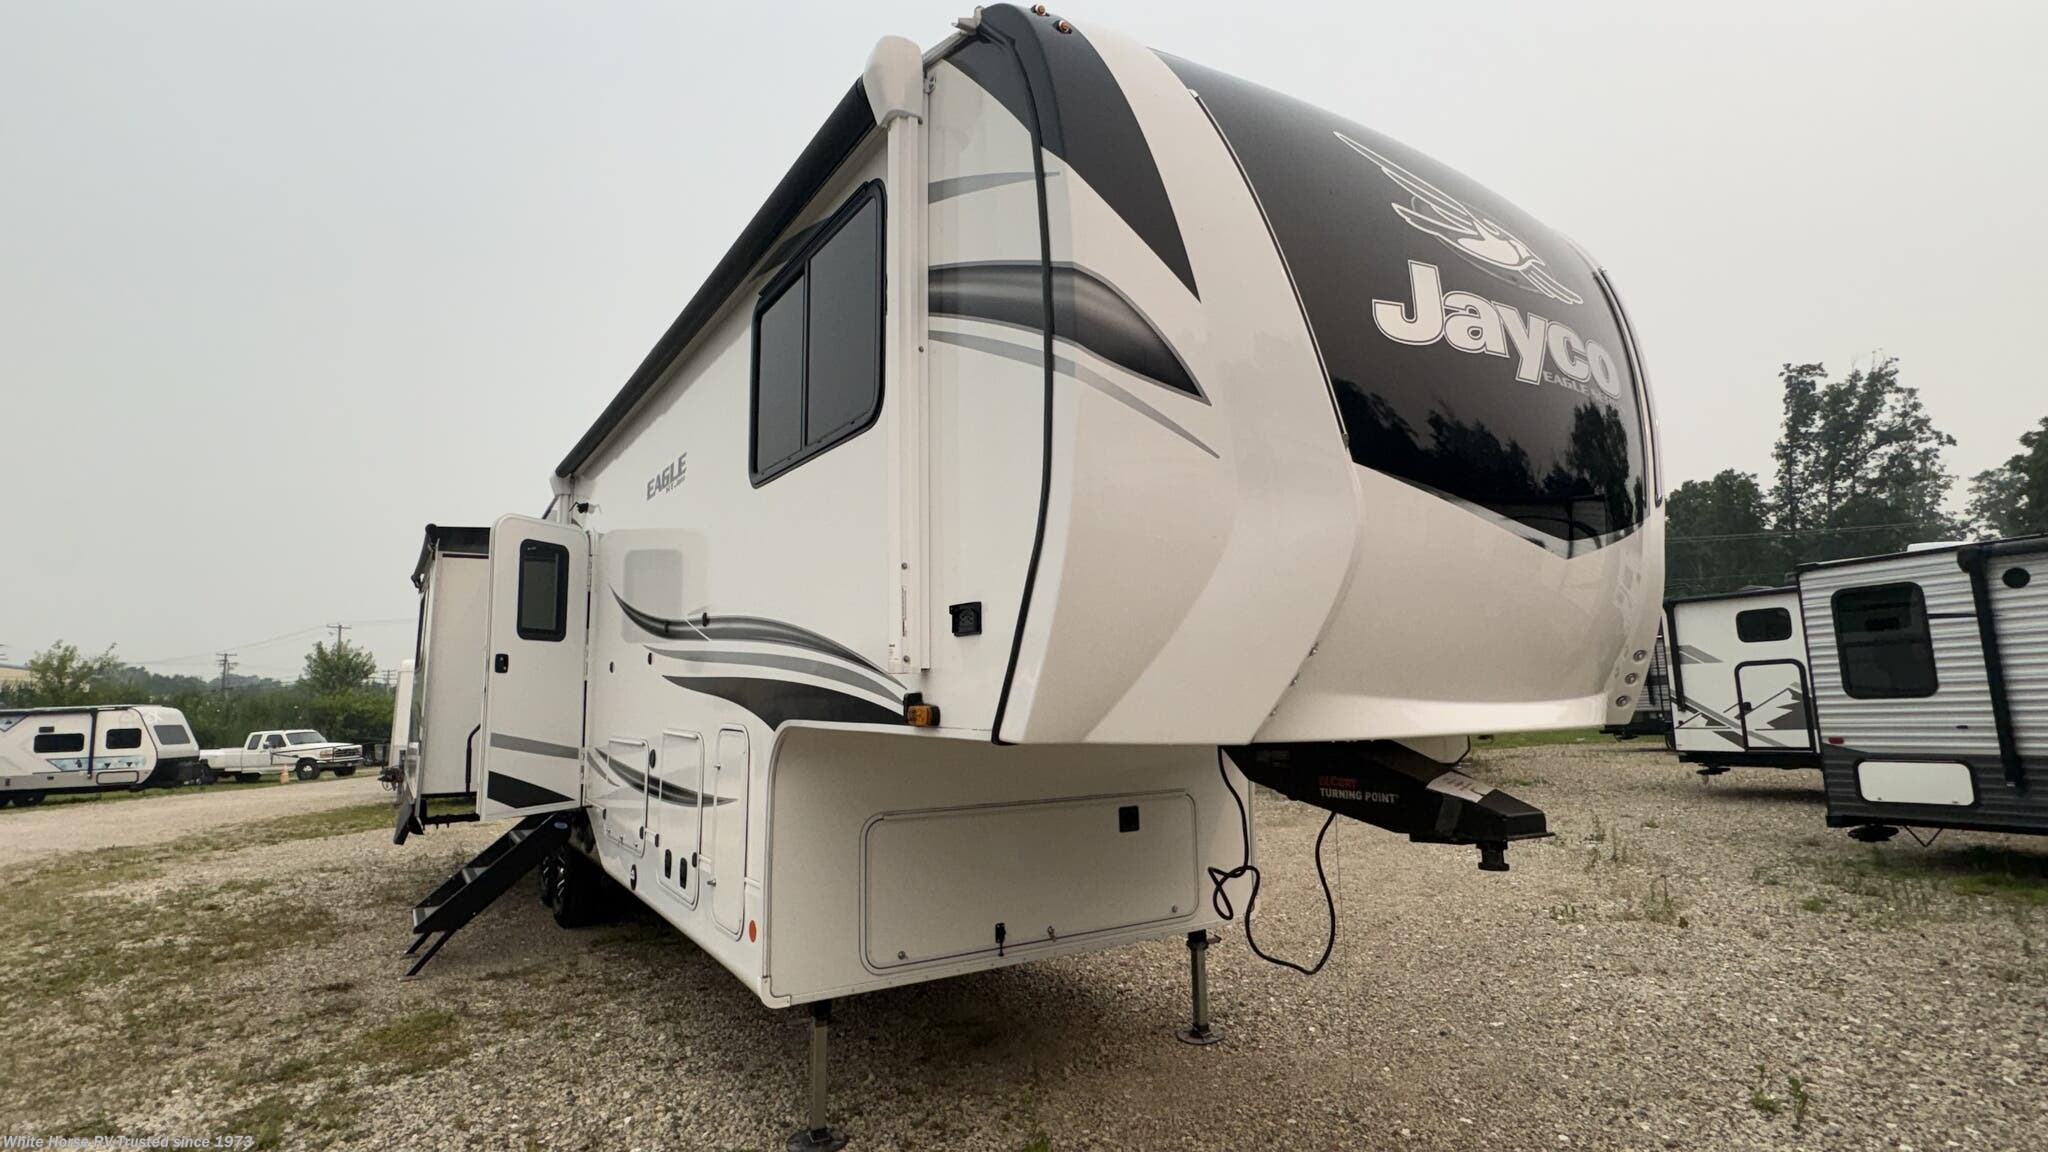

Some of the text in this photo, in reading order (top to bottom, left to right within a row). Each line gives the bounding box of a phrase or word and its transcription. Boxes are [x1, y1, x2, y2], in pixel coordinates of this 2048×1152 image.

[1371, 259, 1623, 398] Jayco
[1543, 370, 1589, 393] EAGLE
[646, 451, 688, 502] EAGLE
[1319, 787, 1363, 801] TURNING
